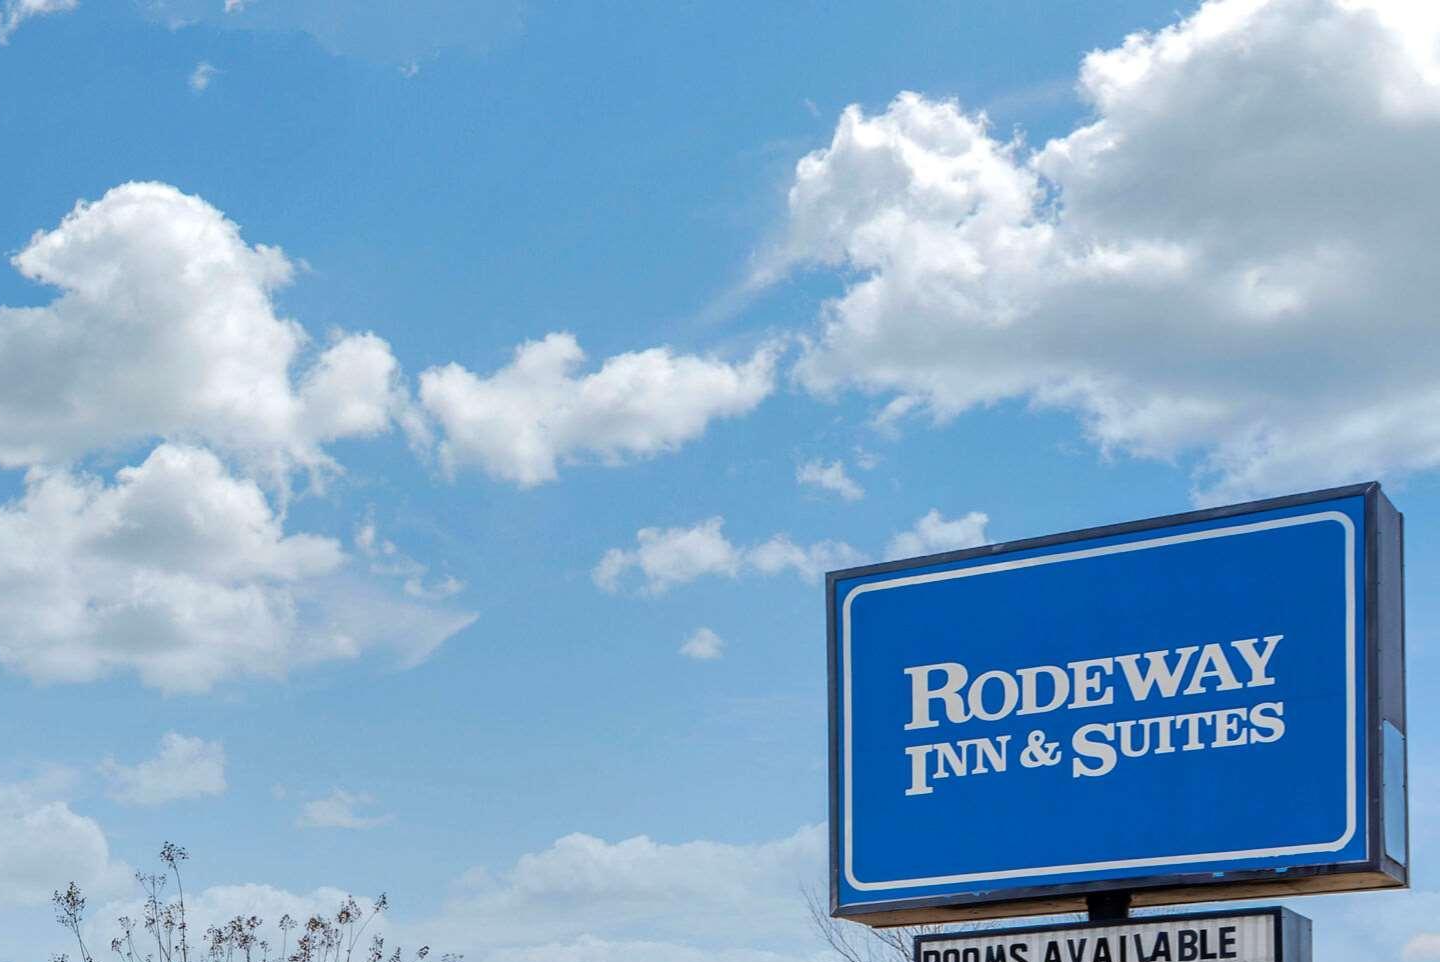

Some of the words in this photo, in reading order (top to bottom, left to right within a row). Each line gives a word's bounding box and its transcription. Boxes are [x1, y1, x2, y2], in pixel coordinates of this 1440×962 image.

[903, 634, 1284, 730] RODEWAY
[904, 735, 1011, 796] INN
[1020, 730, 1062, 768] &
[1071, 701, 1285, 778] SUITES
